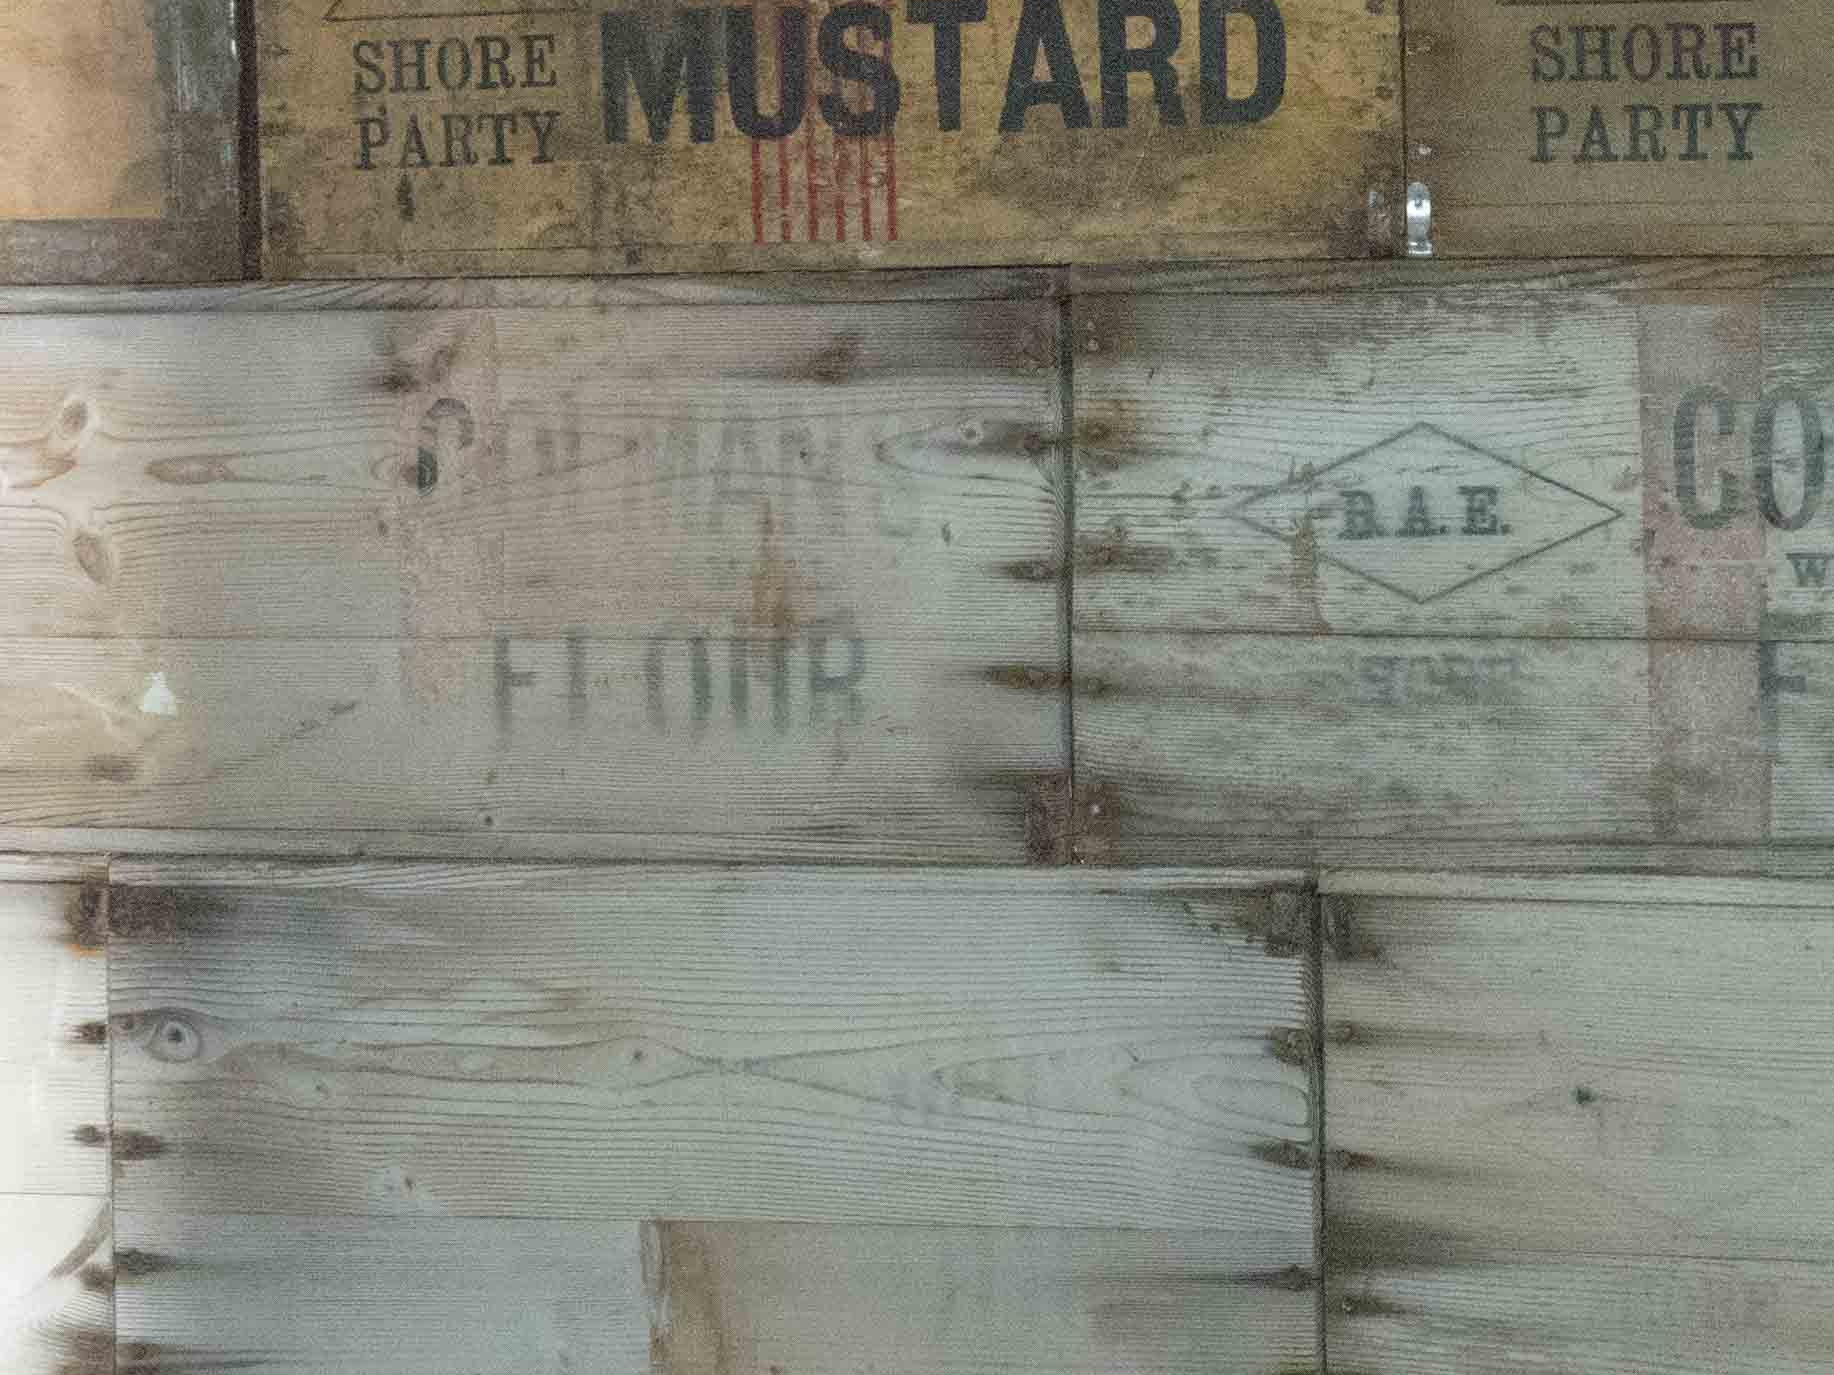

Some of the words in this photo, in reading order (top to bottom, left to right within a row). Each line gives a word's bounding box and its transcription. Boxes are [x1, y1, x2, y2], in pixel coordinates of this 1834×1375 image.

[352, 32, 559, 97] SHORE
[1528, 21, 1760, 85] SHORE
[351, 108, 563, 172] PARTY
[1527, 100, 1764, 165] PARTY
